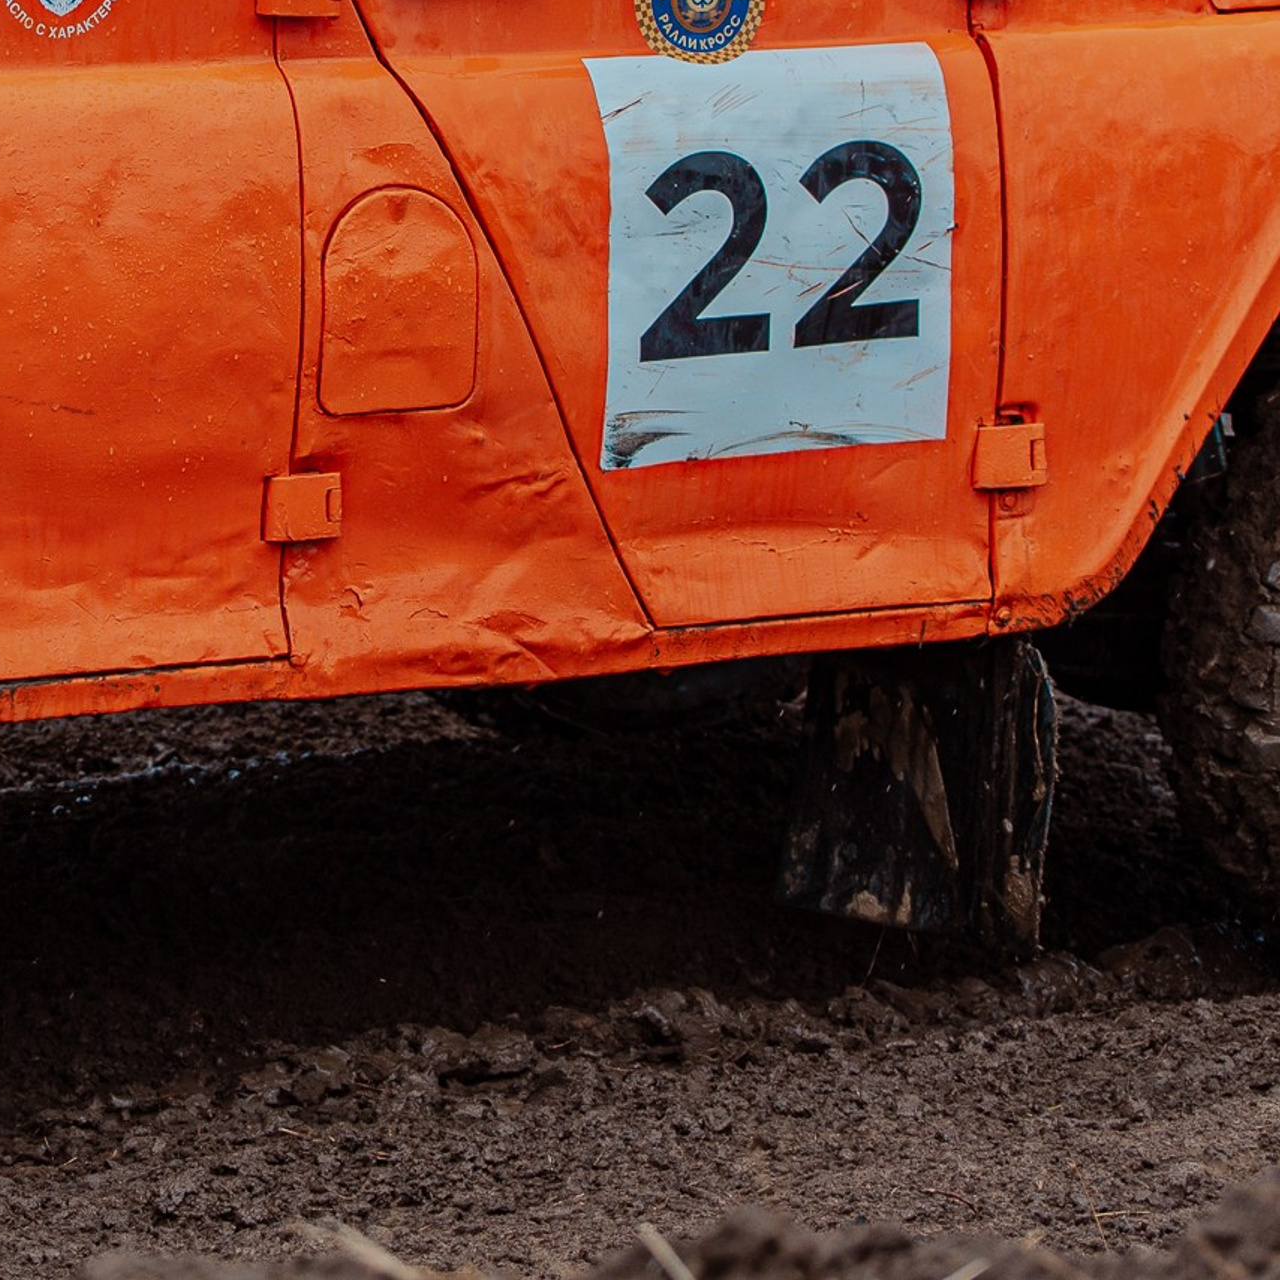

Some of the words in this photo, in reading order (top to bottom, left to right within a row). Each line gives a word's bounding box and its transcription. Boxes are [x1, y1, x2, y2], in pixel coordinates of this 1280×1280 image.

[35, 23, 46, 36] С
[658, 13, 741, 51] РАЛЛИКРОСС
[639, 139, 922, 362] 22
